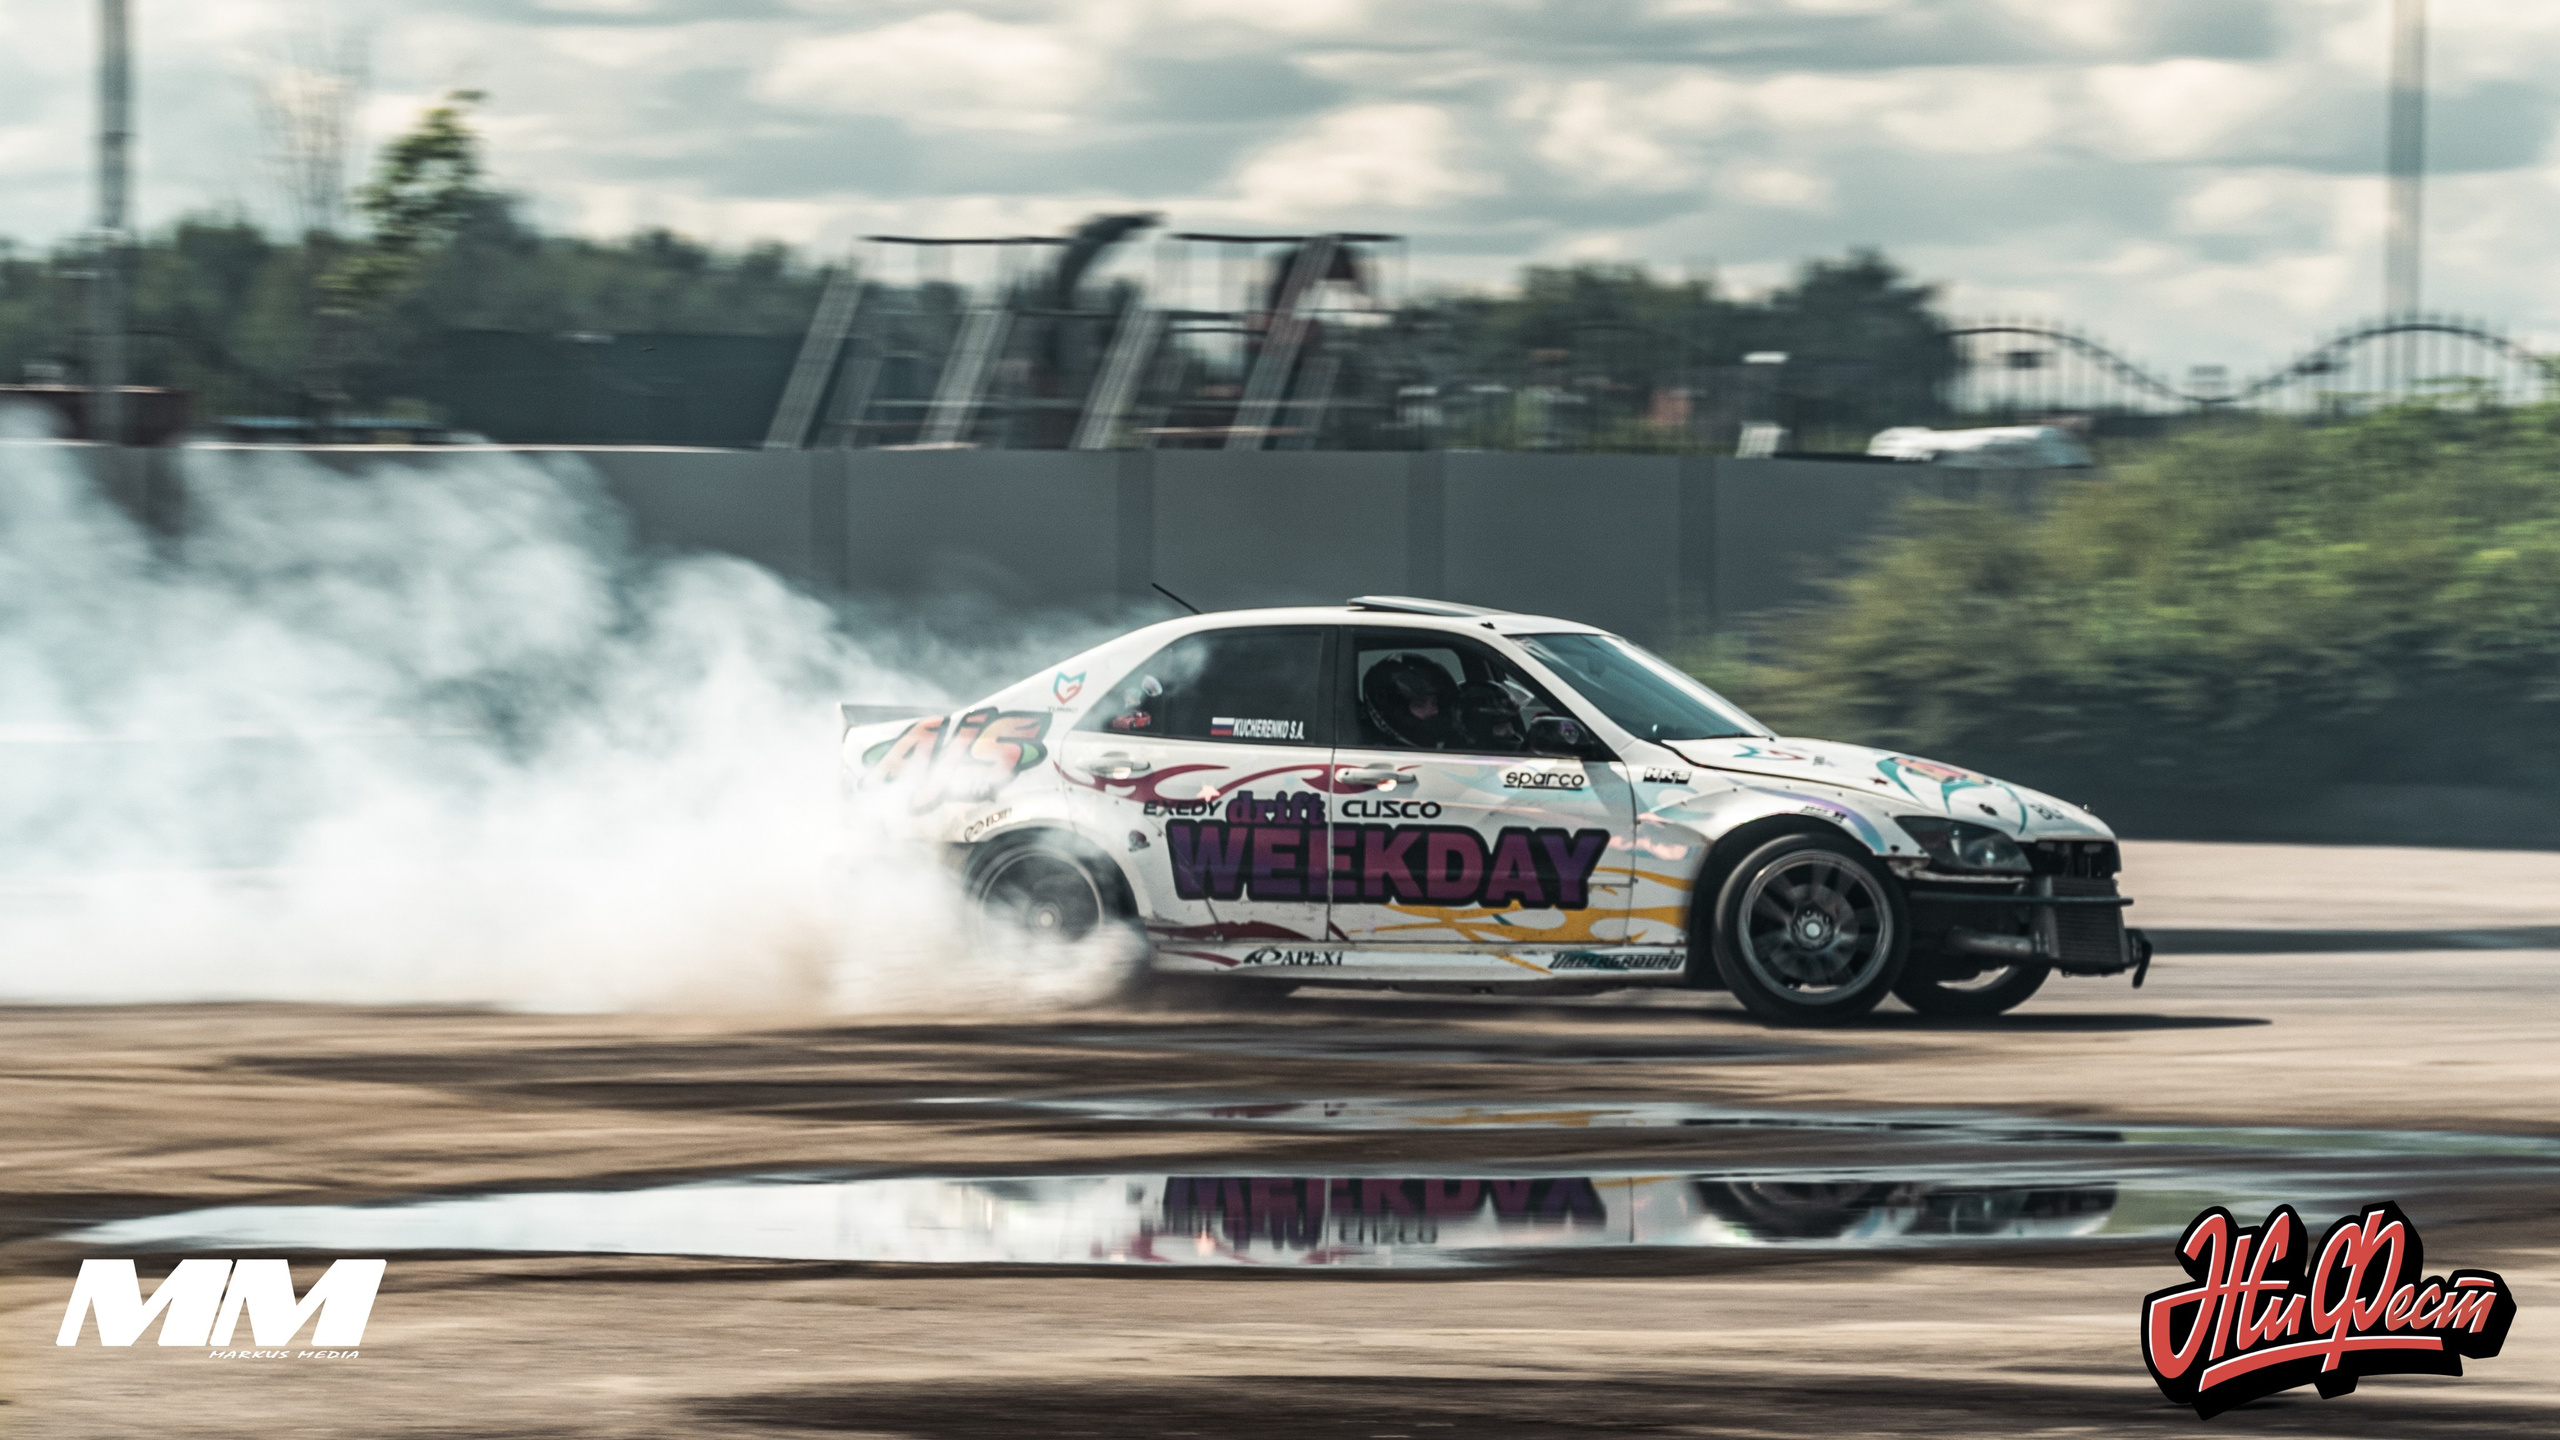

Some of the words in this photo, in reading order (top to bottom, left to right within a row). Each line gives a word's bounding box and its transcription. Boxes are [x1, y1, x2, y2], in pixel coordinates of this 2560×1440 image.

[1233, 718, 1289, 739] KUCHERENKO
[1505, 771, 1585, 789] sparco
[1143, 801, 1222, 816] EXEDY
[1226, 790, 1326, 826] drift
[1341, 800, 1443, 819] CUSCO
[1166, 819, 1609, 909] WEEKDAY
